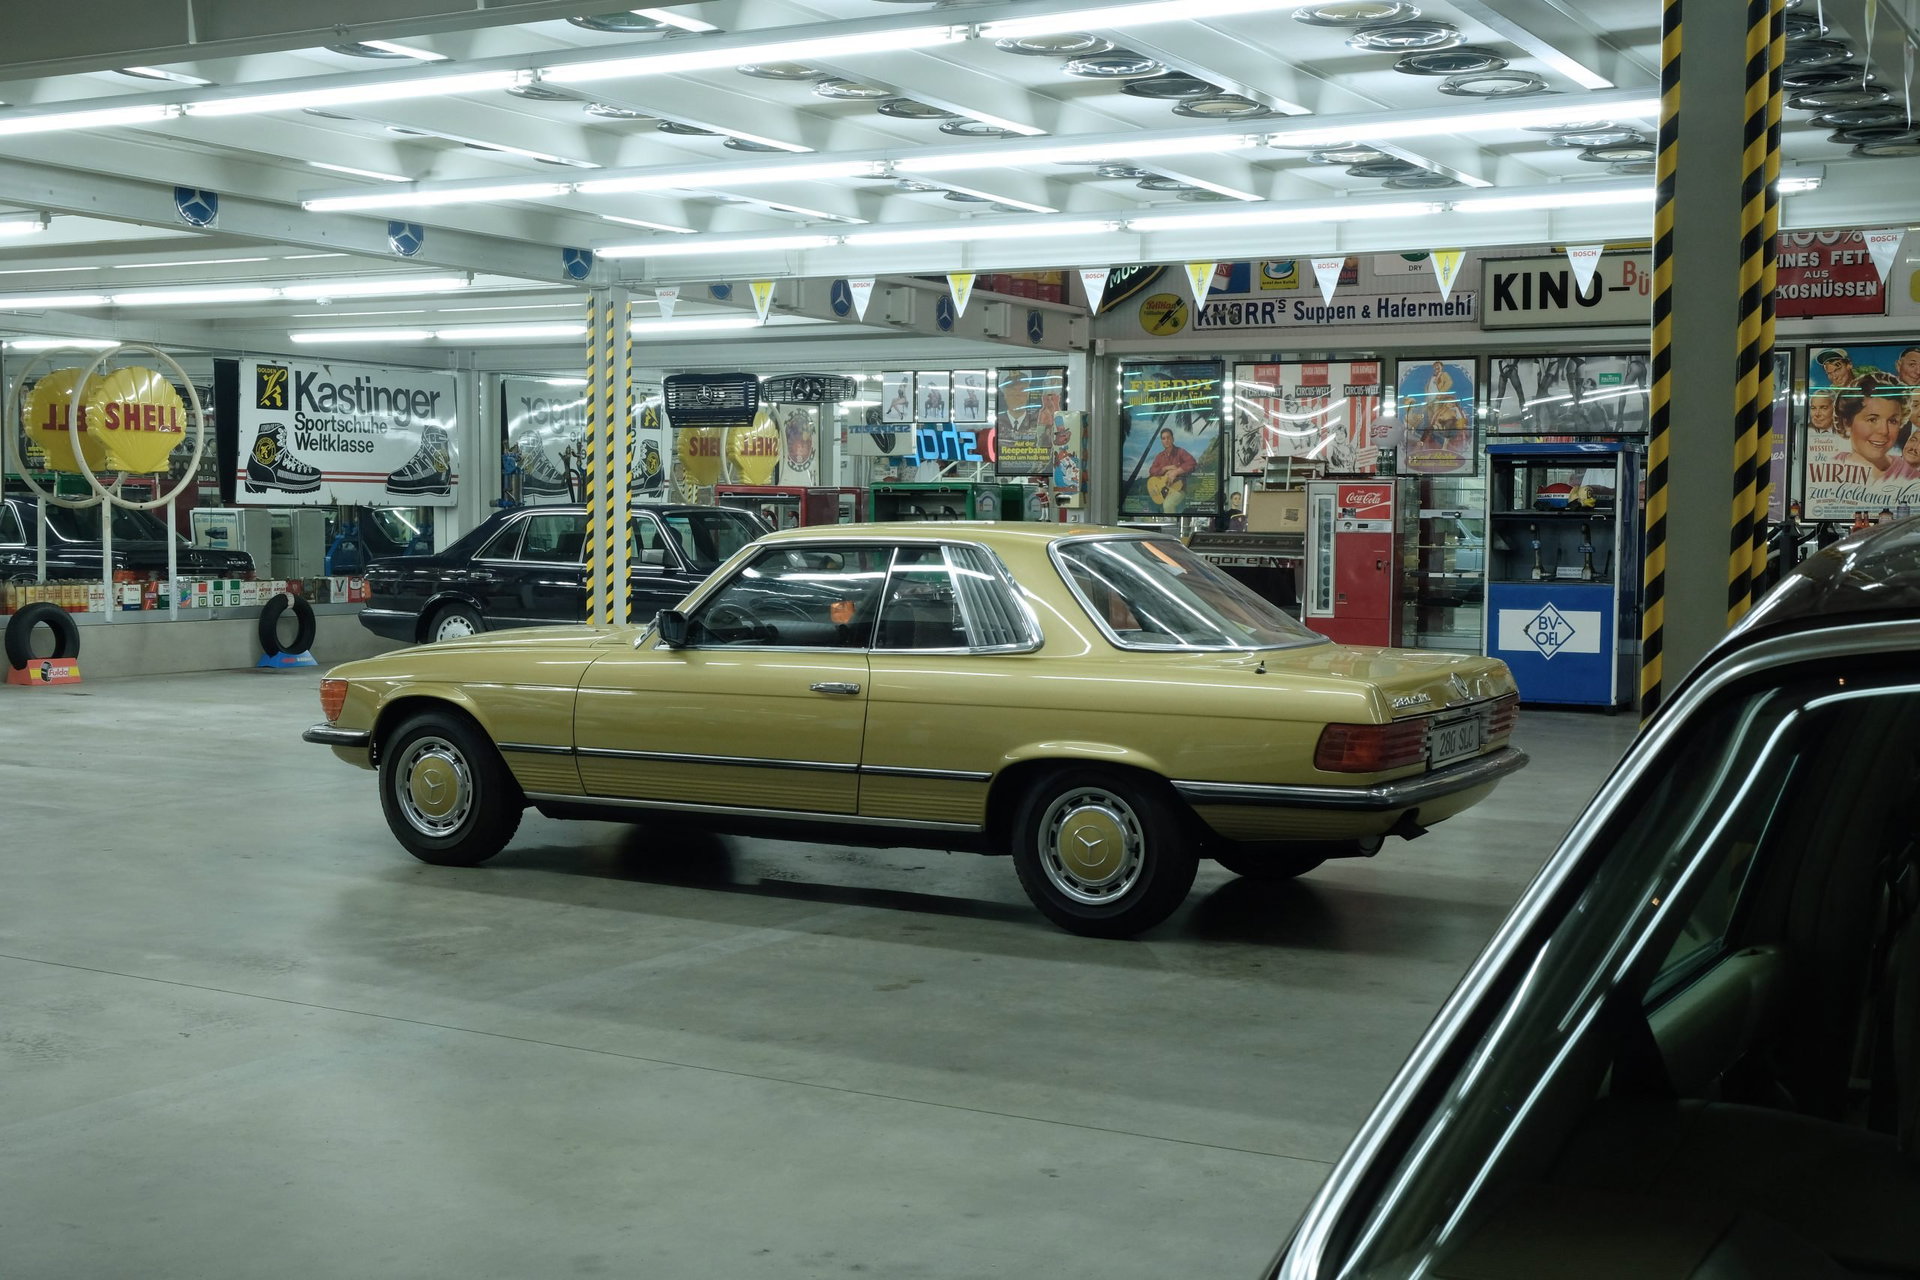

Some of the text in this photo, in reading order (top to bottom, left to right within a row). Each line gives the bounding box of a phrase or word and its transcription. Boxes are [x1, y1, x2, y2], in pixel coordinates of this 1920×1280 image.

[1870, 234, 1897, 243] BOSCH
[1803, 270, 1830, 278] AUS
[1493, 260, 1650, 311] KINO-Bü
[1775, 280, 1878, 299] KOSNÜSSEN
[1293, 300, 1356, 324] Suppen
[1361, 304, 1371, 319] &
[1377, 294, 1472, 319] Hafermehl
[257, 366, 276, 374] GOLDEN
[1129, 378, 1213, 392] FREDDY
[1296, 385, 1330, 397] CIRCUS-WELT
[294, 369, 441, 428] Kastinger
[105, 402, 182, 433] SHELL
[294, 411, 388, 435] Sportschuhe
[294, 431, 375, 454] Weltklasse
[689, 436, 721, 457] SHE
[1001, 446, 1048, 456] Reeperbahn
[1808, 462, 1872, 486] WIRTIN
[1346, 491, 1384, 504] Coca-Cola
[1538, 616, 1563, 630] BV-
[1535, 631, 1562, 646] OEL
[1439, 724, 1473, 757] 280 SLC
